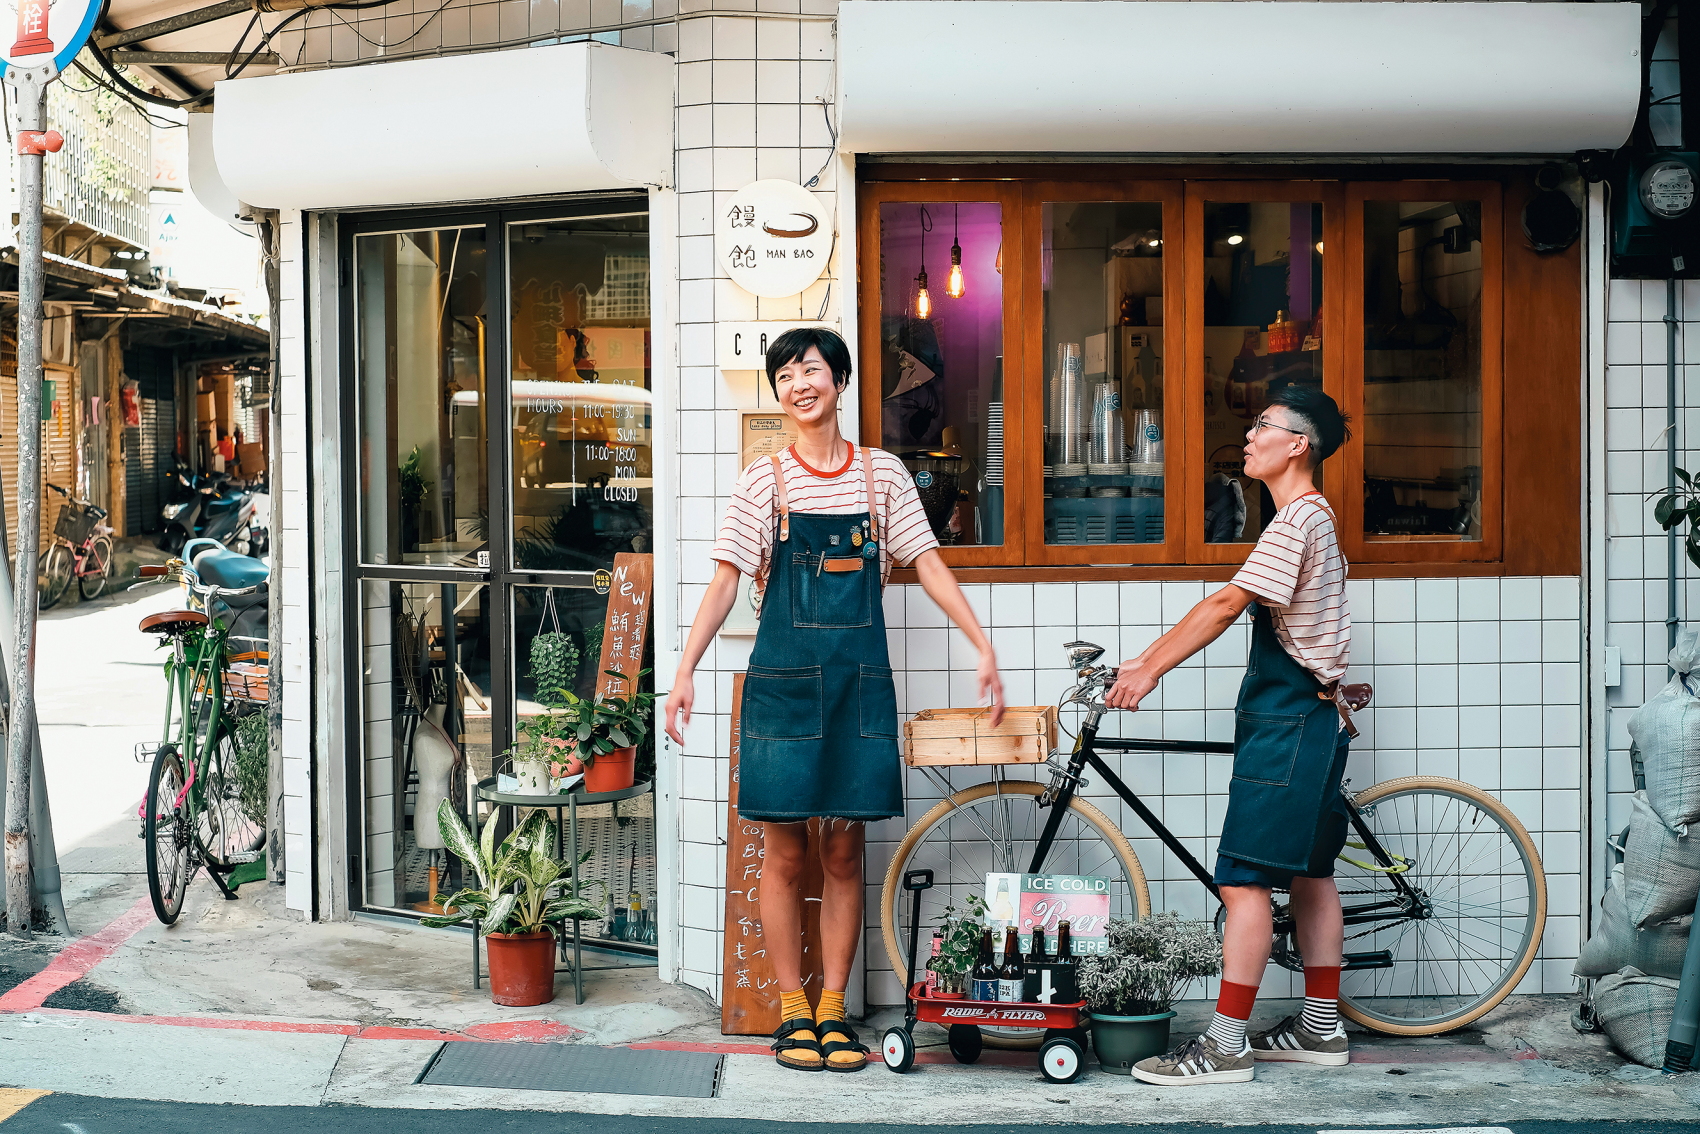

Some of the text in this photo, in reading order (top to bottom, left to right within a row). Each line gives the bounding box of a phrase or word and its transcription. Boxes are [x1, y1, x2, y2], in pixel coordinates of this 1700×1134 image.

[22, 3, 43, 35] 栓
[766, 249, 815, 259] MAN BAO
[527, 398, 564, 414] HOURS
[583, 404, 635, 419] 11:00-19:30
[616, 428, 637, 442] SUN
[615, 466, 637, 481] MON
[604, 485, 637, 502] CLOSED
[1027, 877, 1106, 891] ICE COLD
[1024, 897, 1106, 933] Beer
[1021, 938, 1106, 953] SD HERE
[941, 1007, 1045, 1020] RADIO FLYER
